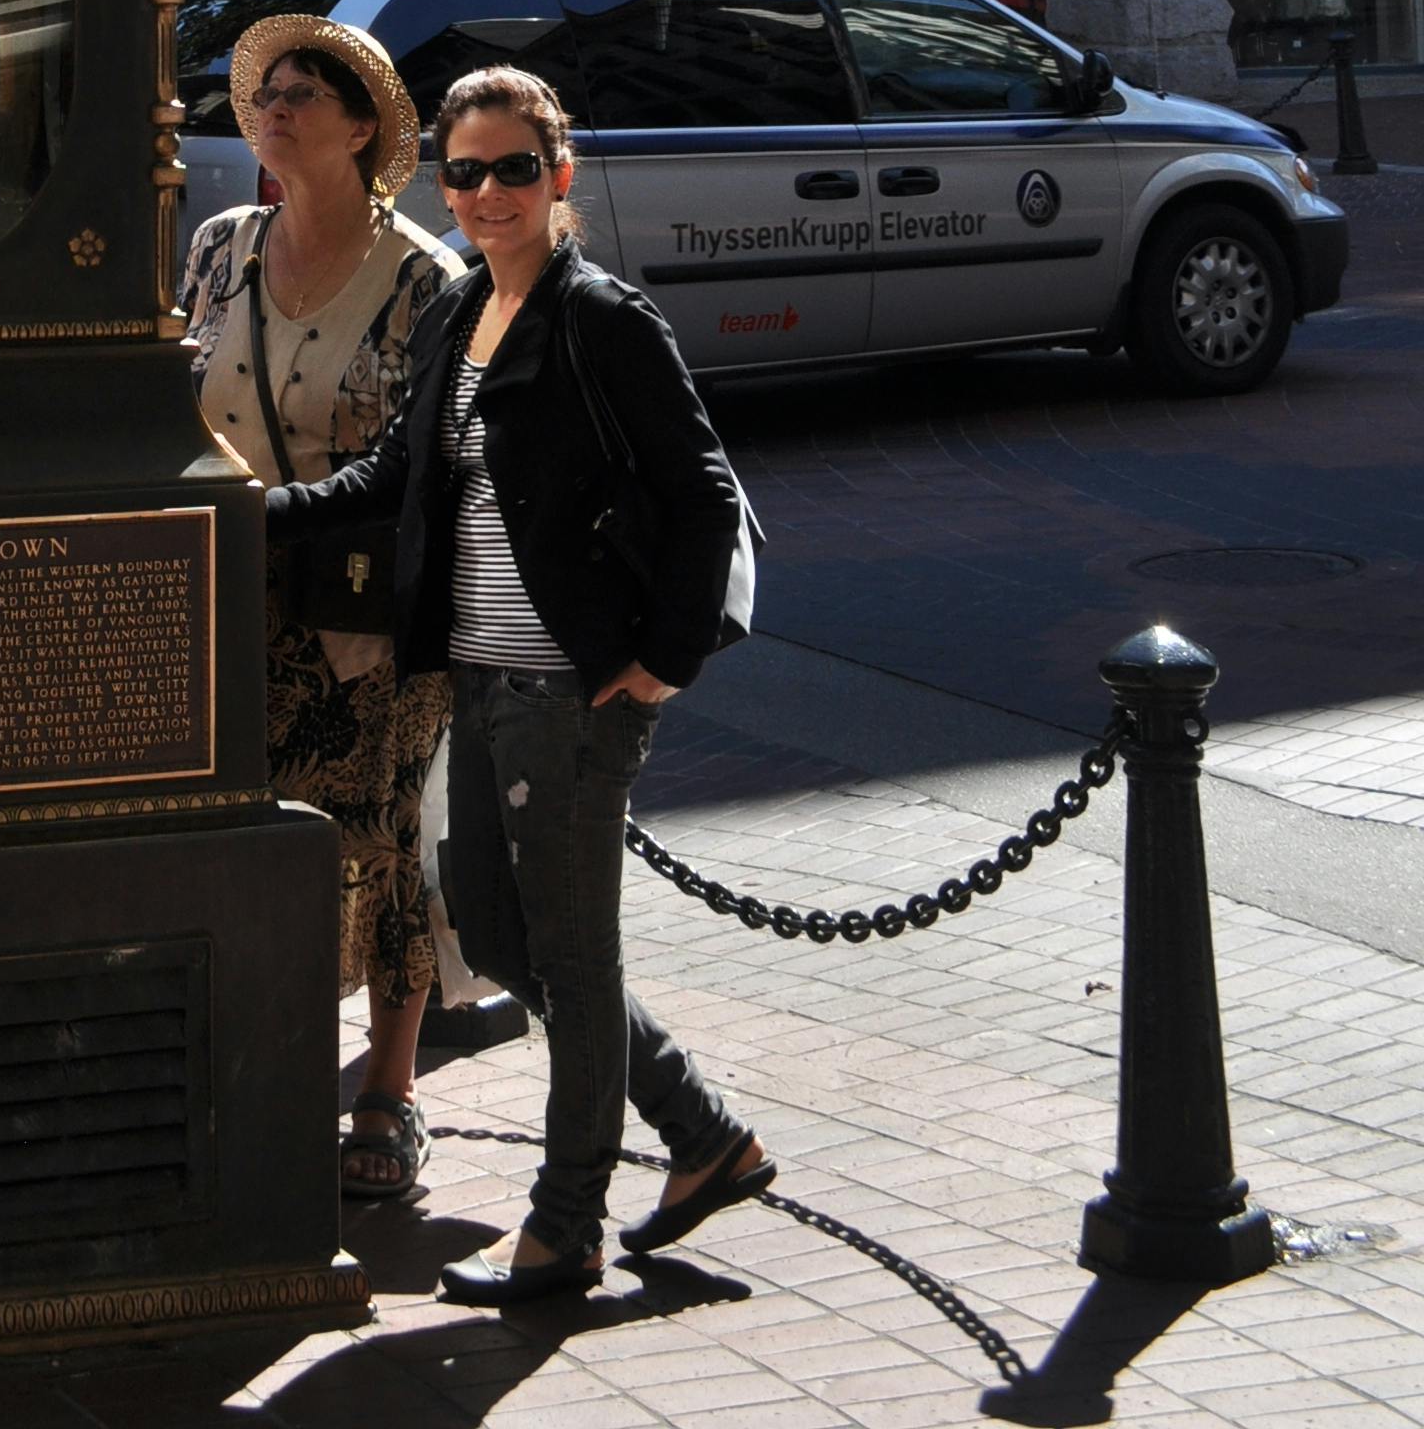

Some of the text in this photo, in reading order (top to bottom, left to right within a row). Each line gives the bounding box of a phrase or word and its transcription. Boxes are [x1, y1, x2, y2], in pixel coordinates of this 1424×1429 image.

[671, 210, 986, 258] ThyssenKrupp Elevator
[719, 311, 783, 334] team
[20, 568, 42, 578] THE
[50, 564, 111, 576] WESTERN
[118, 559, 190, 572] BOUNDARY
[45, 578, 95, 590] KNOWN
[25, 594, 64, 605] INLET
[72, 592, 98, 602] WAS
[105, 589, 140, 600] ONLY
[161, 586, 188, 596] FEW
[4, 607, 64, 619] THROUGH
[103, 602, 144, 613] EARLY
[25, 620, 78, 631] CENTRE
[0, 636, 21, 646] THE
[27, 633, 77, 644] CENTRE
[37, 647, 63, 657] WAS
[65, 640, 168, 655] REHABILITATED
[55, 660, 72, 669] ITS
[79, 652, 189, 668] REHABILITATION
[105, 669, 132, 679] AND
[137, 667, 160, 677] ALL
[32, 684, 103, 698] TOGETHER
[112, 681, 147, 693] WITH
[157, 679, 189, 689] CITY
[77, 698, 104, 708] THE
[115, 692, 189, 706] TOWNSITE
[26, 711, 98, 725] PROPERTY
[108, 707, 166, 719] OWNERS
[13, 728, 40, 739] FOR
[48, 726, 71, 736] THE
[79, 718, 190, 734] BEAUTIFICATION
[27, 740, 75, 752] SERVED
[98, 733, 170, 747] CHAIRMAN
[18, 755, 47, 767] 1967
